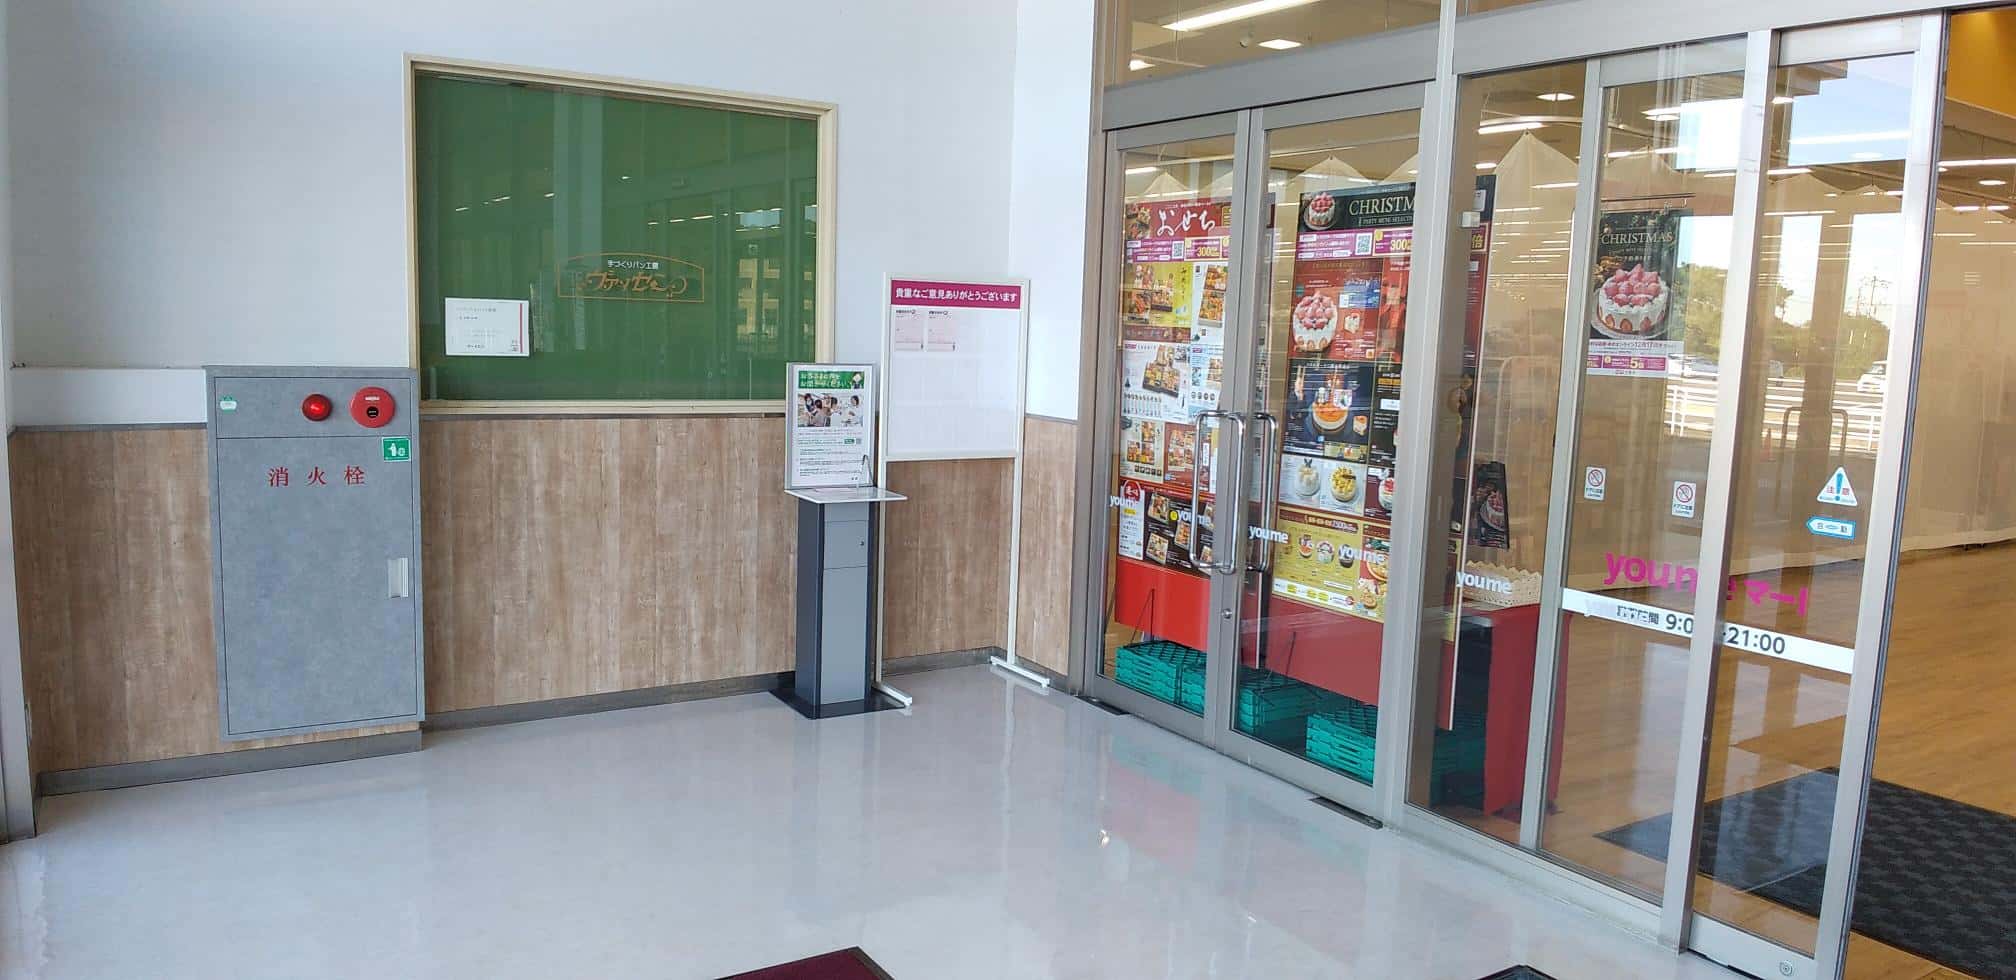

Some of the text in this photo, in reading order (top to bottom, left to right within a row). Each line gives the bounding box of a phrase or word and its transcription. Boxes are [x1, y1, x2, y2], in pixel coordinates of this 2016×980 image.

[1157, 209, 1216, 236] おせち
[1601, 231, 1673, 245] CHRISTMAS
[895, 287, 1018, 303] 貴重なご意見ありがとうございます
[268, 465, 366, 487] 消火栓
